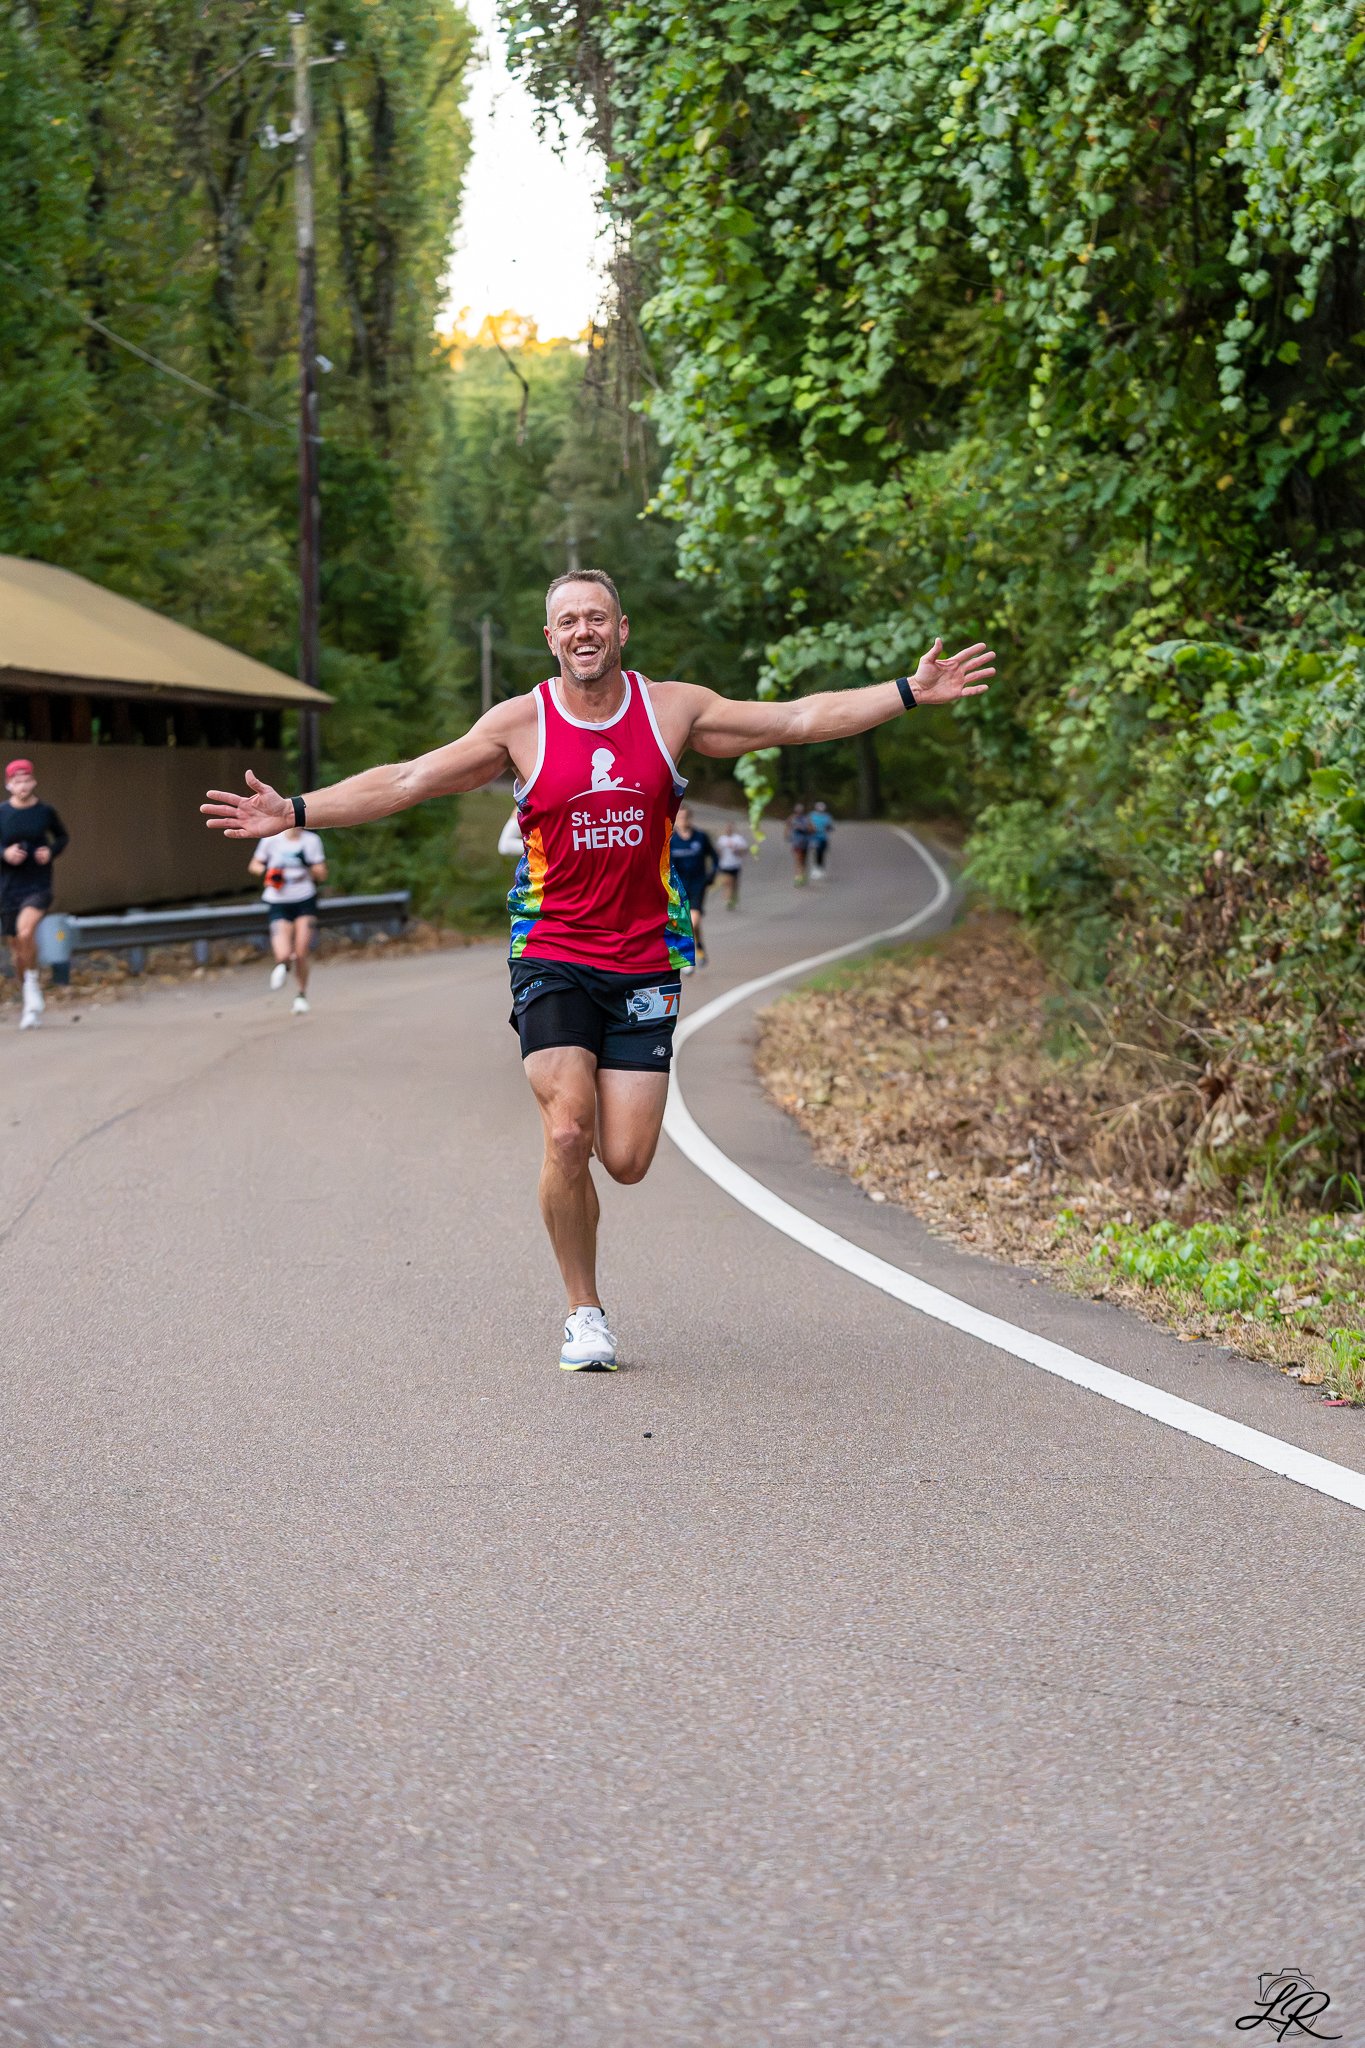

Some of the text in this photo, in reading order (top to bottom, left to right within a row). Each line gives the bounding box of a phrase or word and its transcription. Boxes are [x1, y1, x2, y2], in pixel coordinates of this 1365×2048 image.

[571, 806, 645, 827] St. Jude
[572, 824, 644, 851] HERO
